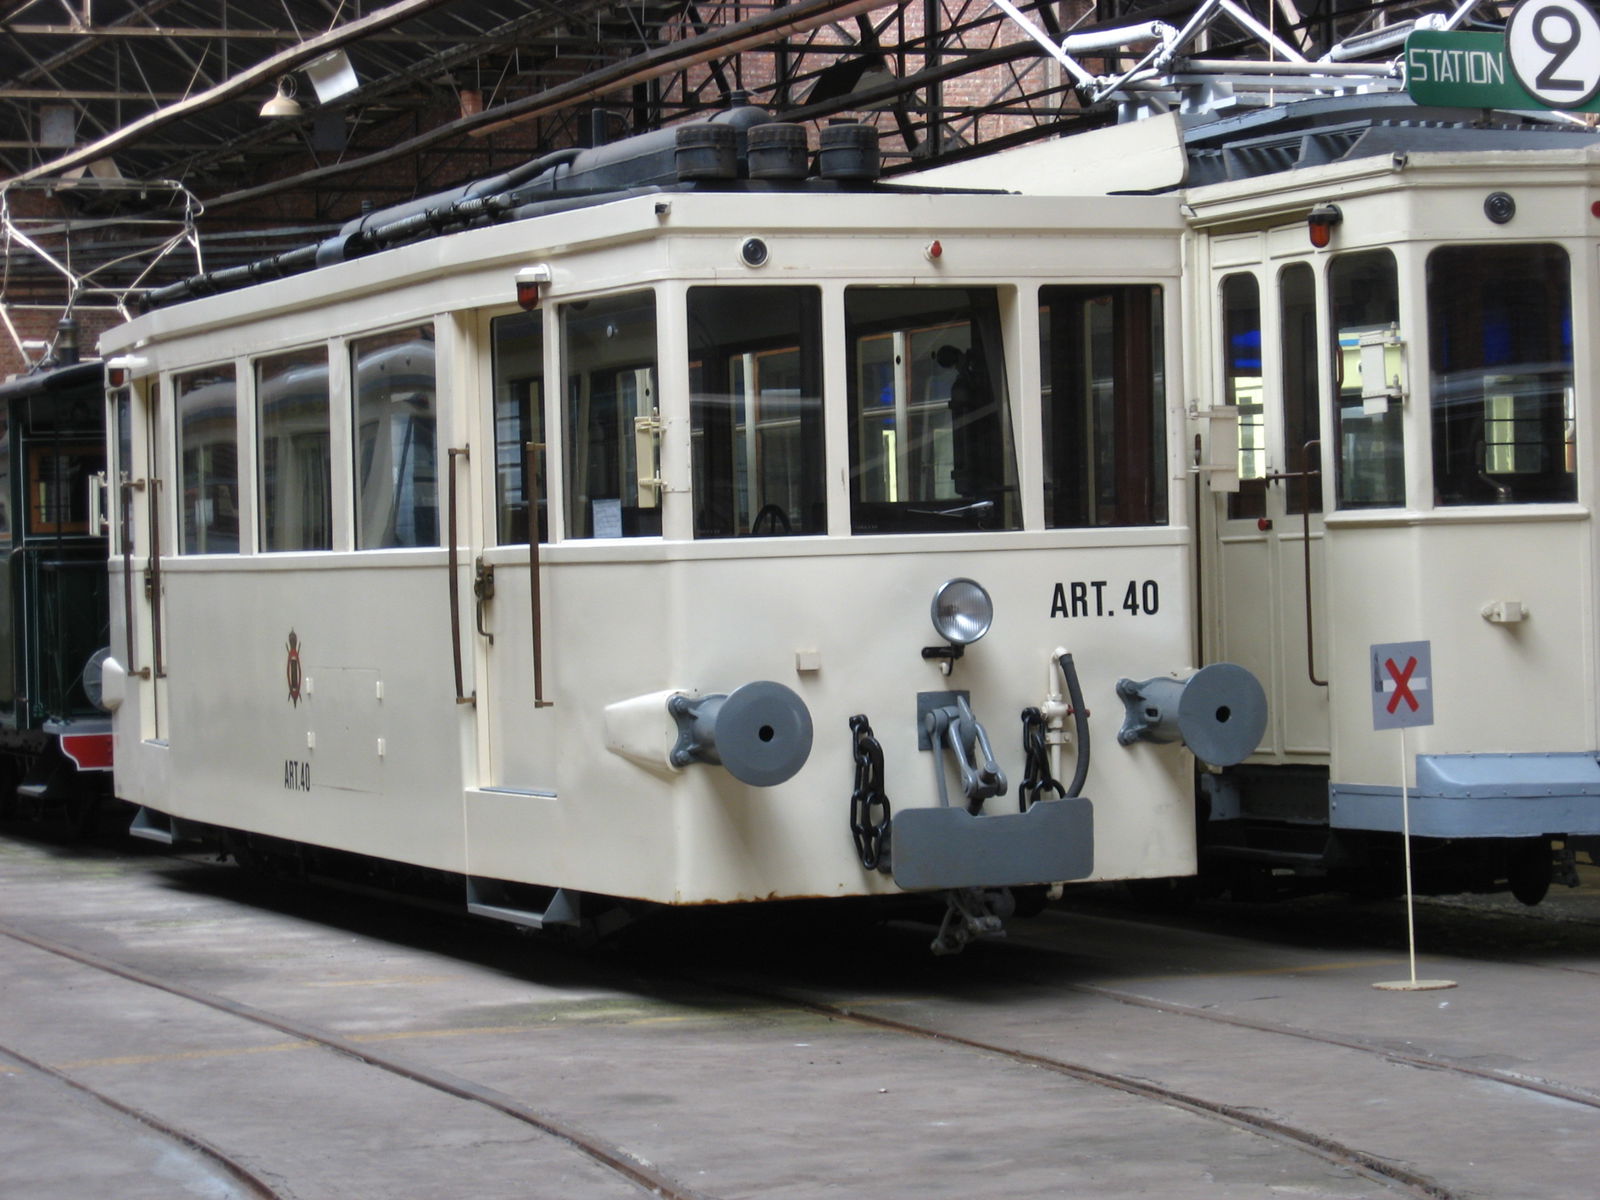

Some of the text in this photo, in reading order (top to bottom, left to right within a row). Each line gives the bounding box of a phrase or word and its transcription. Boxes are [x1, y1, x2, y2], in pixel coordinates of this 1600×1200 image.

[1409, 5, 1585, 91] STATION 2
[1050, 579, 1159, 618] ART. 40
